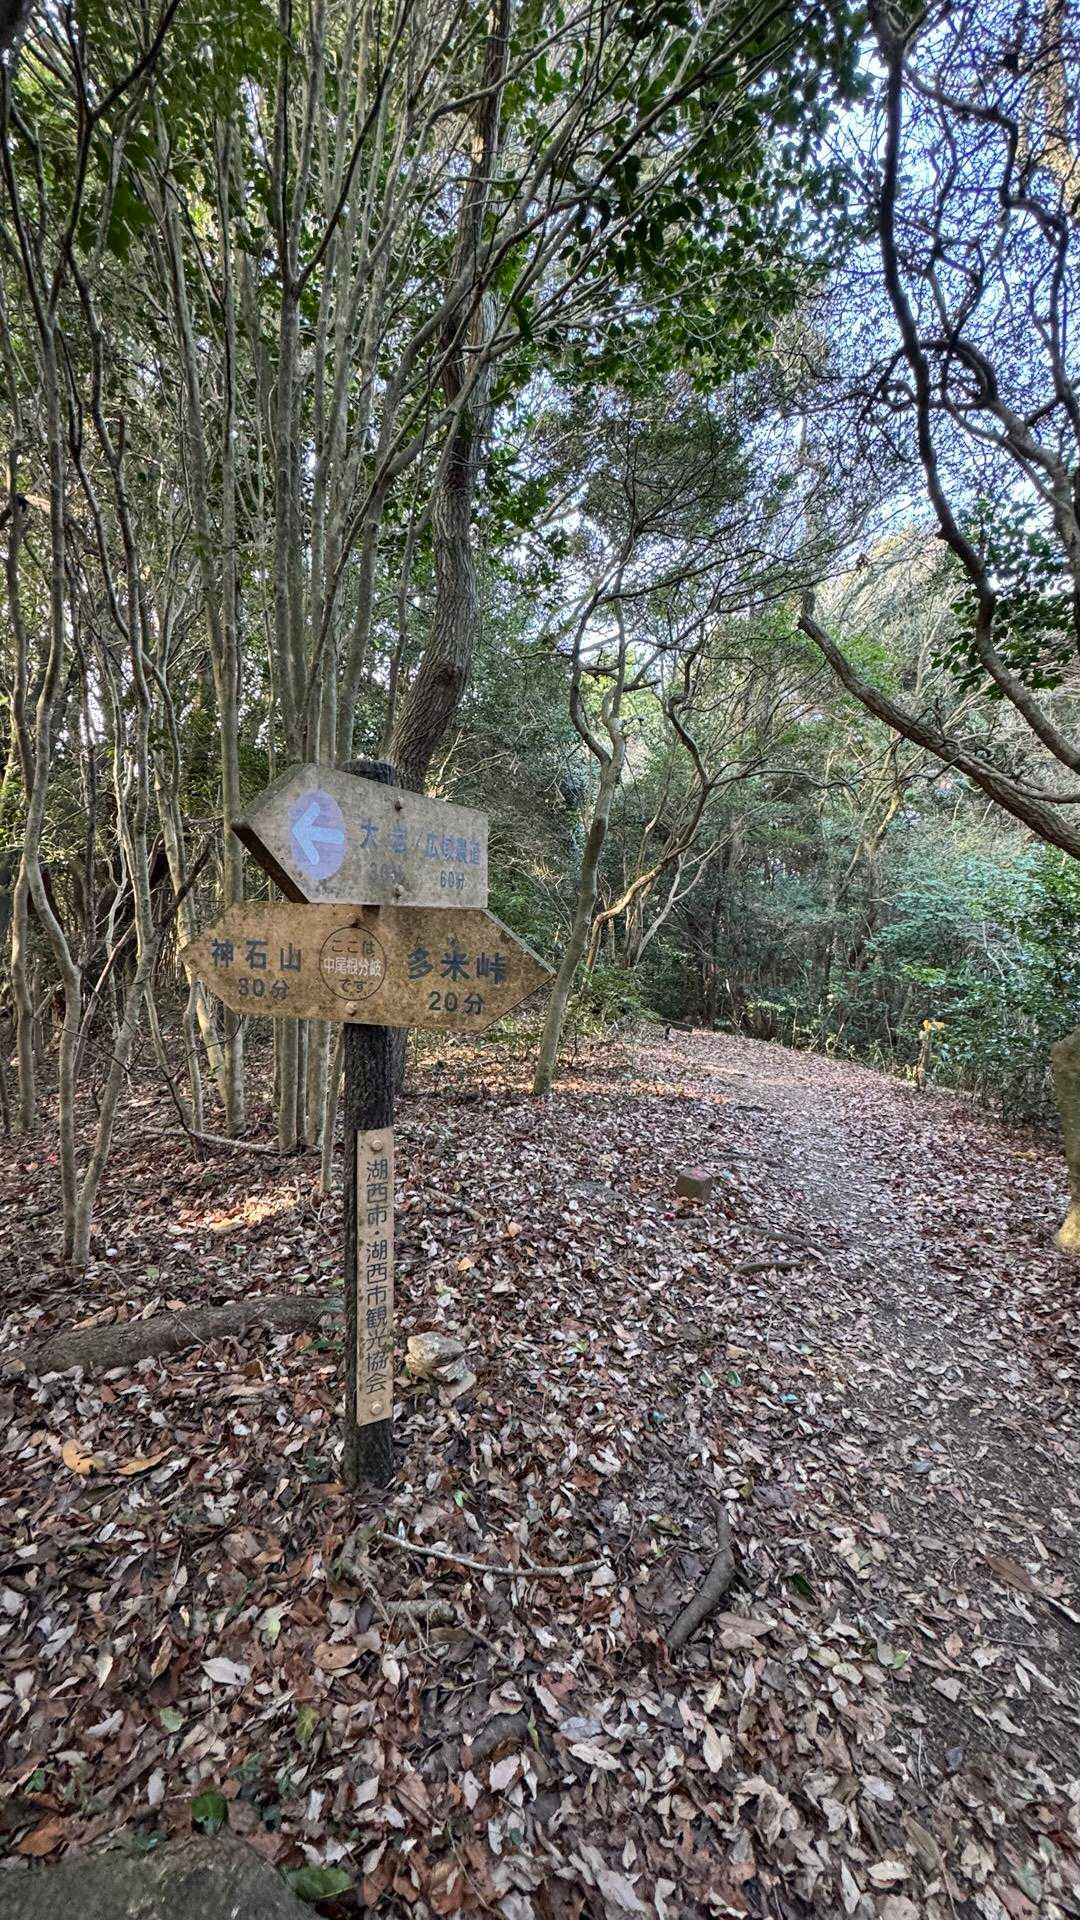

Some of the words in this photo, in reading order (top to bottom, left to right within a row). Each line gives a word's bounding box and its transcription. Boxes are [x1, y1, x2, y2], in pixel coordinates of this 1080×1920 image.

[440, 870, 465, 889] 60分
[210, 938, 301, 972] 神石山
[331, 939, 375, 957] ここは
[407, 947, 507, 985] 多米峠
[339, 978, 367, 993] です
[428, 991, 484, 1015] 20分
